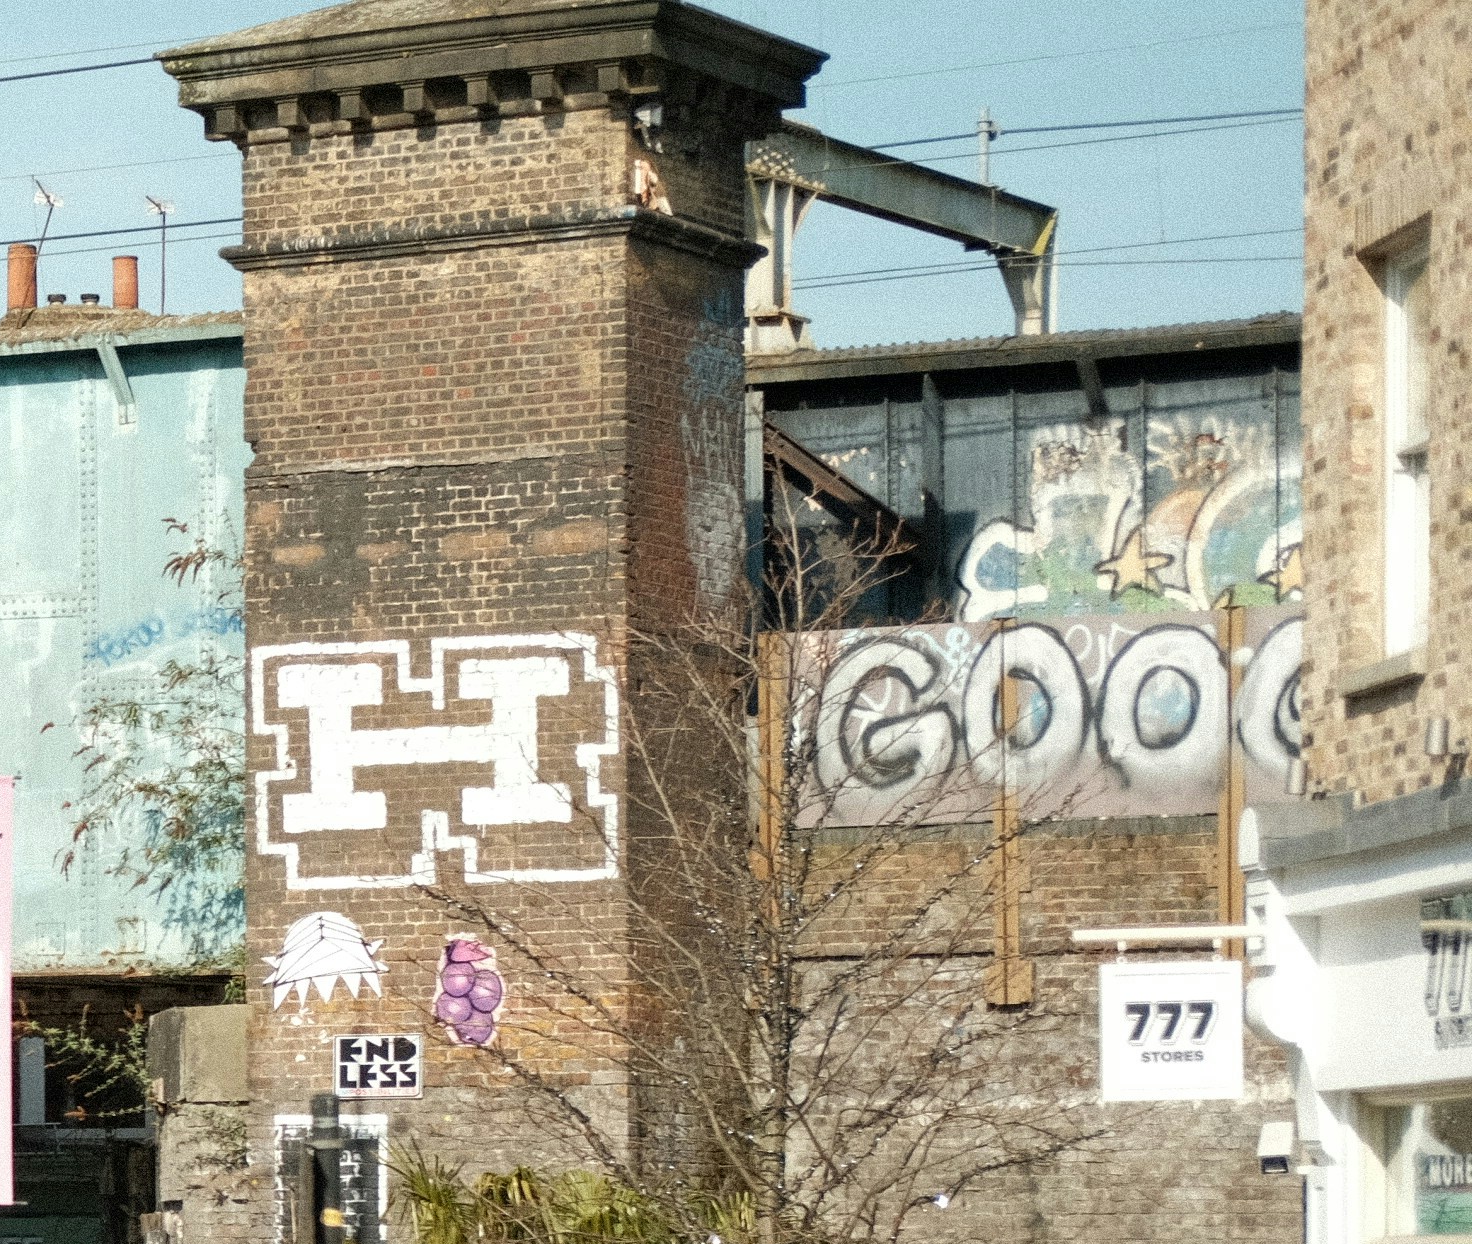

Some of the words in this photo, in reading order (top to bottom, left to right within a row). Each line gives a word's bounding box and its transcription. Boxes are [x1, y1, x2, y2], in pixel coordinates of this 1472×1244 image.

[1124, 999, 1220, 1047] 777
[339, 1037, 417, 1062] END
[1141, 1050, 1205, 1063] STORES
[339, 1063, 417, 1088] LESS
